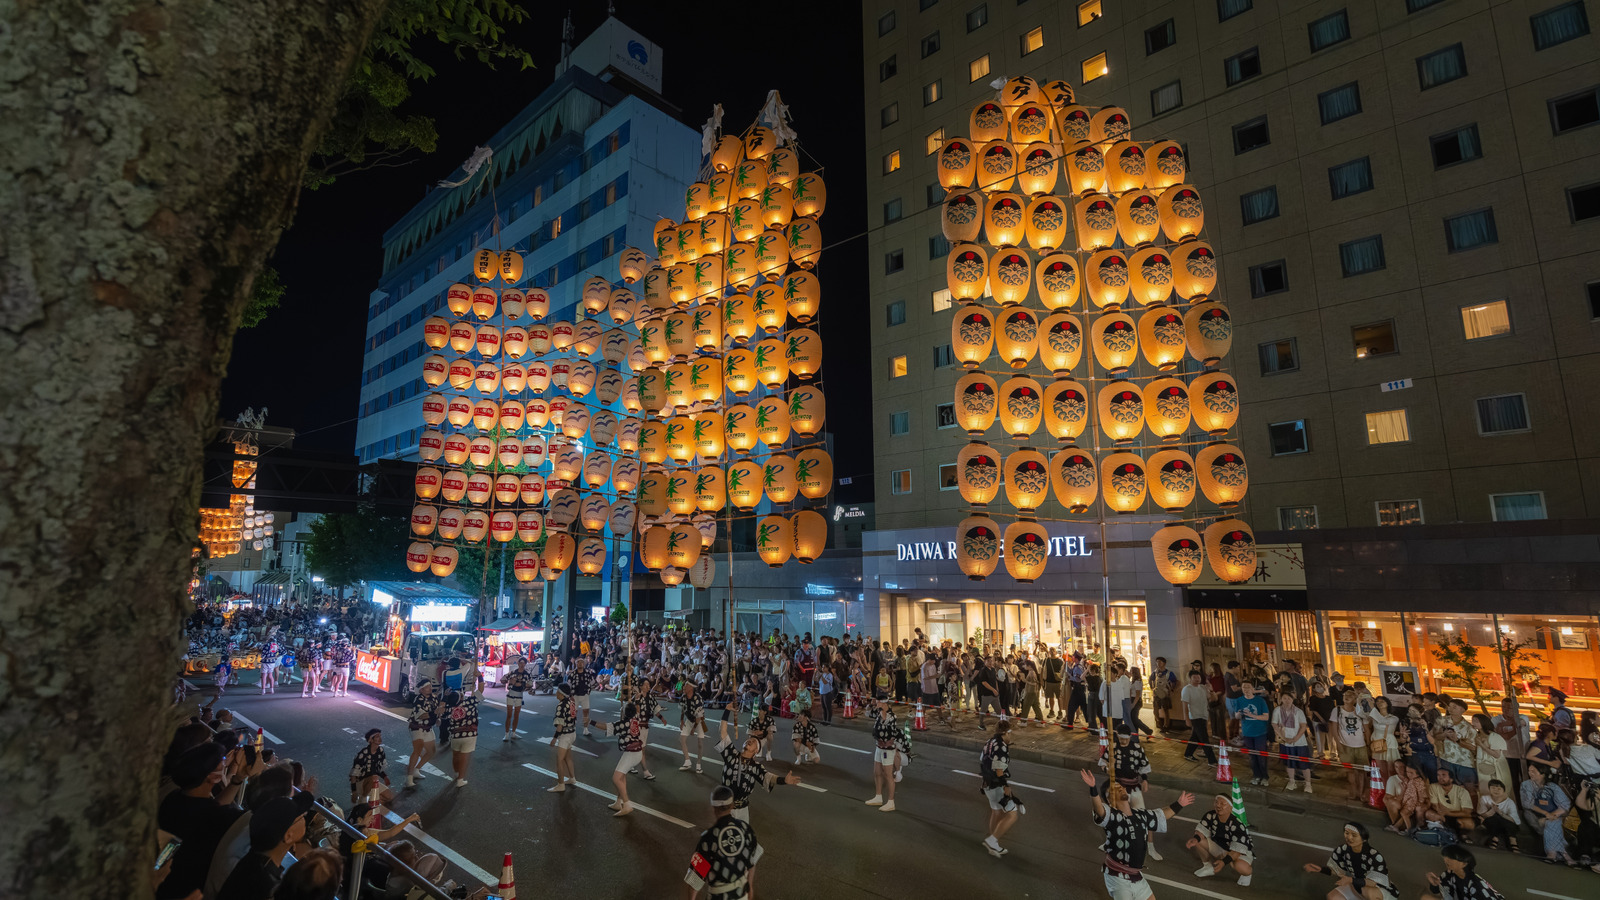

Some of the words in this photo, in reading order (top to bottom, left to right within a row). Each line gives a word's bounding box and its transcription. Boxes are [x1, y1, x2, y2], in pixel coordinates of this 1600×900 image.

[1012, 76, 1033, 100] 七夕
[1054, 81, 1072, 106] 七夕
[749, 128, 764, 152] 七夕
[1387, 380, 1405, 390] 111
[897, 542, 944, 561] DAIWA
[1047, 536, 1093, 557] TEL
